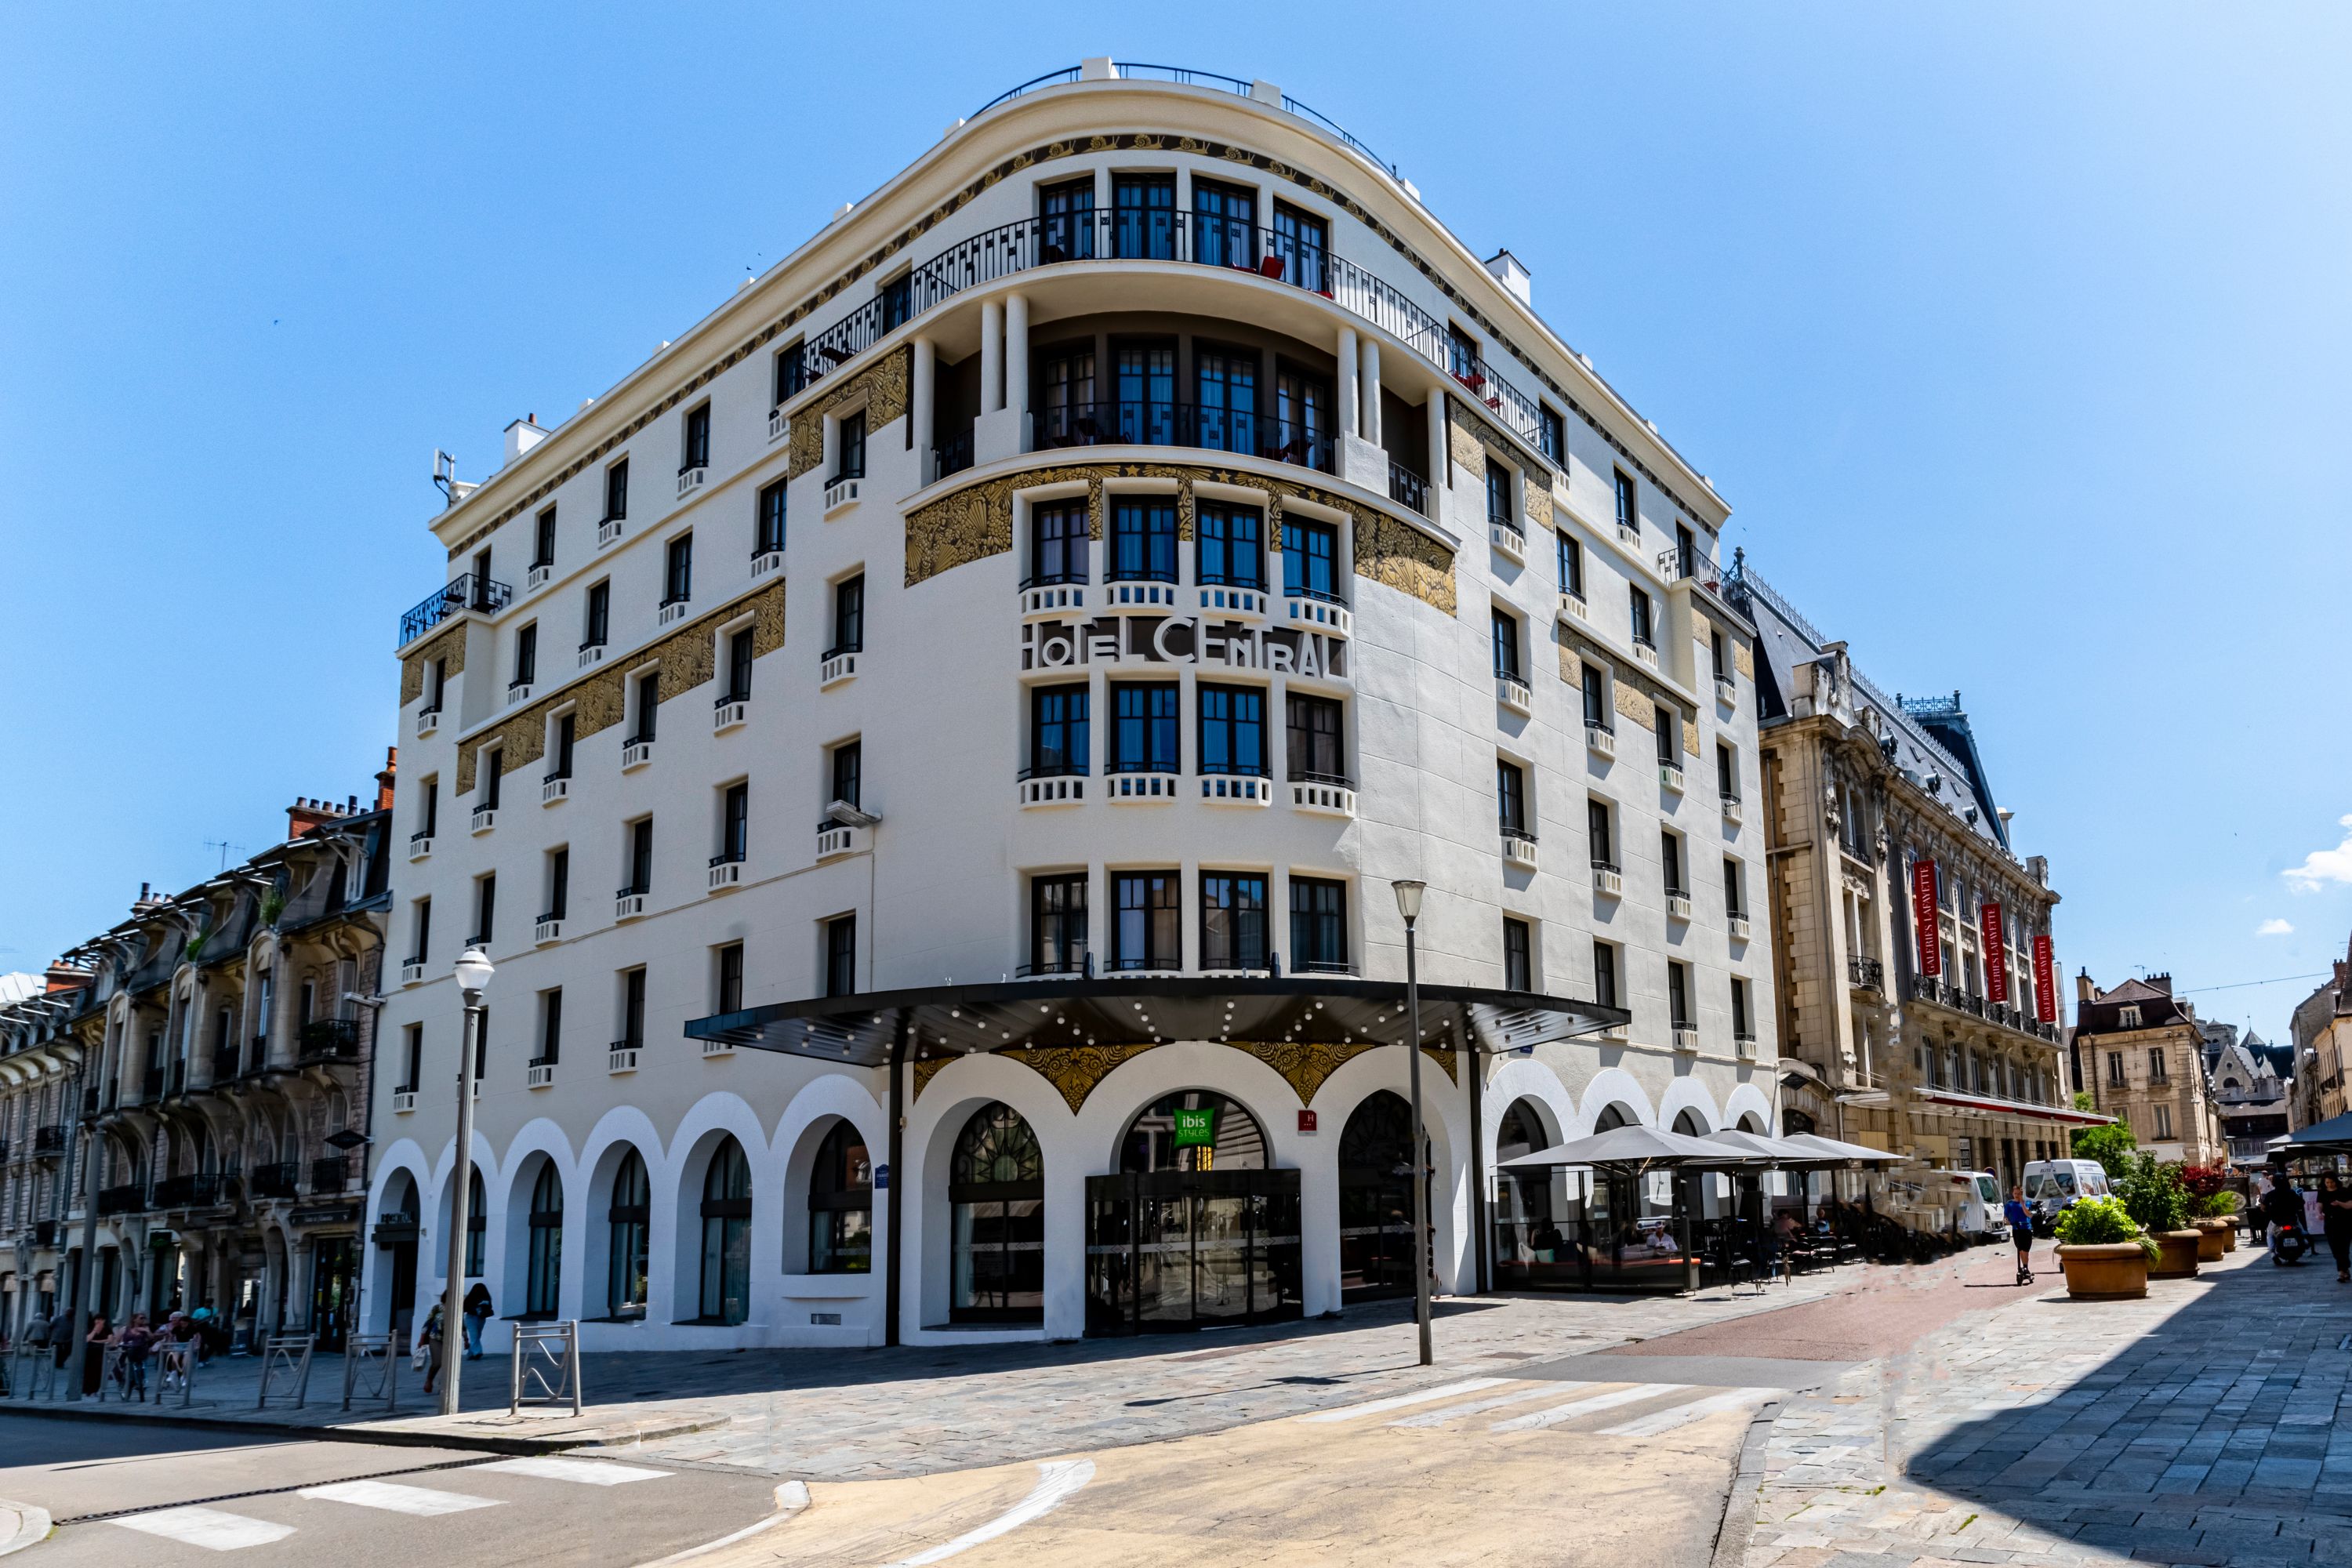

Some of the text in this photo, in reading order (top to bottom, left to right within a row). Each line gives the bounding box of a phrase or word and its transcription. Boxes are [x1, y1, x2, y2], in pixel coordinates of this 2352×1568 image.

[1021, 614, 1348, 678] HOTEL CENTRAL
[1920, 866, 1936, 973] GALERIES LAFAYETTE
[1987, 908, 2002, 1000] GALERIES LAFAYETTE
[2039, 939, 2052, 1020] GALERIES LAFAYETTE
[1182, 1115, 1206, 1128] ibis
